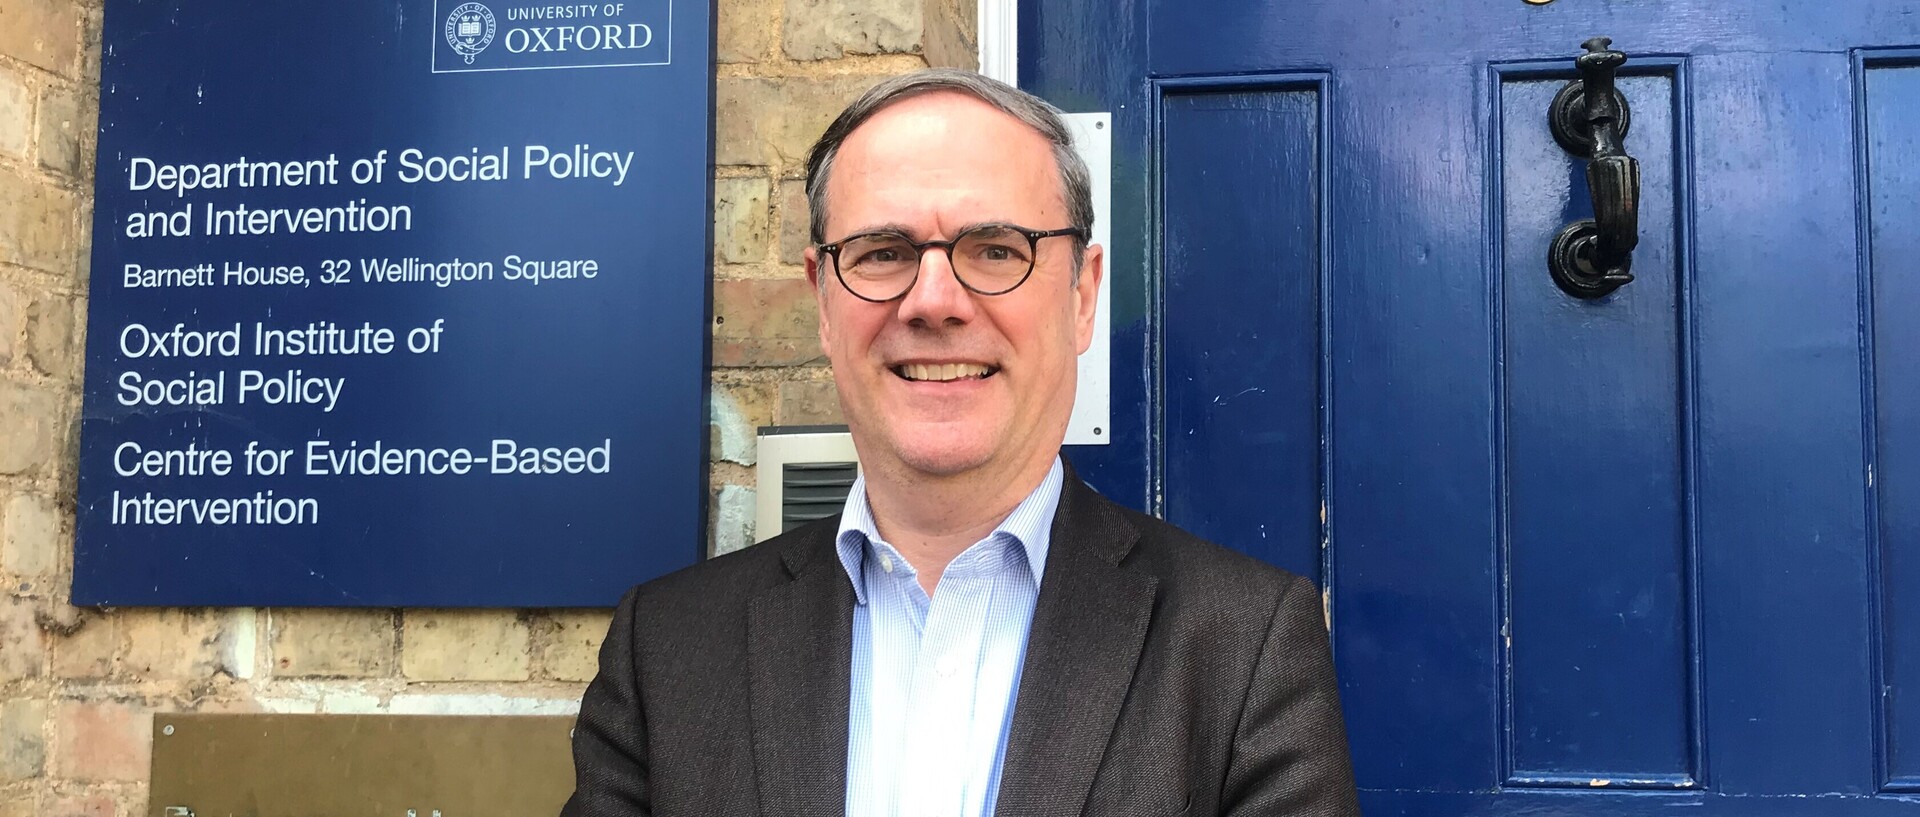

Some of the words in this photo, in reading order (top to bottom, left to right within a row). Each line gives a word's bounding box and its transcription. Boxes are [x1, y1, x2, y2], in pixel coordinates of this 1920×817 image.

[507, 4, 598, 21] UNIVERSITY
[603, 3, 624, 17] OF
[505, 23, 652, 54] OXFORD
[129, 153, 339, 196] Department
[351, 149, 388, 185] of
[398, 146, 509, 183] Social
[524, 143, 635, 186] Policy
[125, 203, 192, 238] and
[206, 198, 412, 236] Intervention
[123, 263, 215, 288] Barnett
[223, 261, 310, 289] House,
[320, 259, 352, 284] 32
[360, 257, 493, 288] Wellington
[503, 254, 599, 286] Square
[120, 322, 241, 358] Oxford
[255, 320, 395, 356] Institute
[407, 318, 445, 354] of
[117, 370, 225, 406] Social
[238, 369, 345, 412] Policy
[113, 441, 233, 477] Centre
[244, 440, 294, 476] for
[306, 438, 611, 475] Evidence-Based
[112, 489, 318, 525] Intervention
